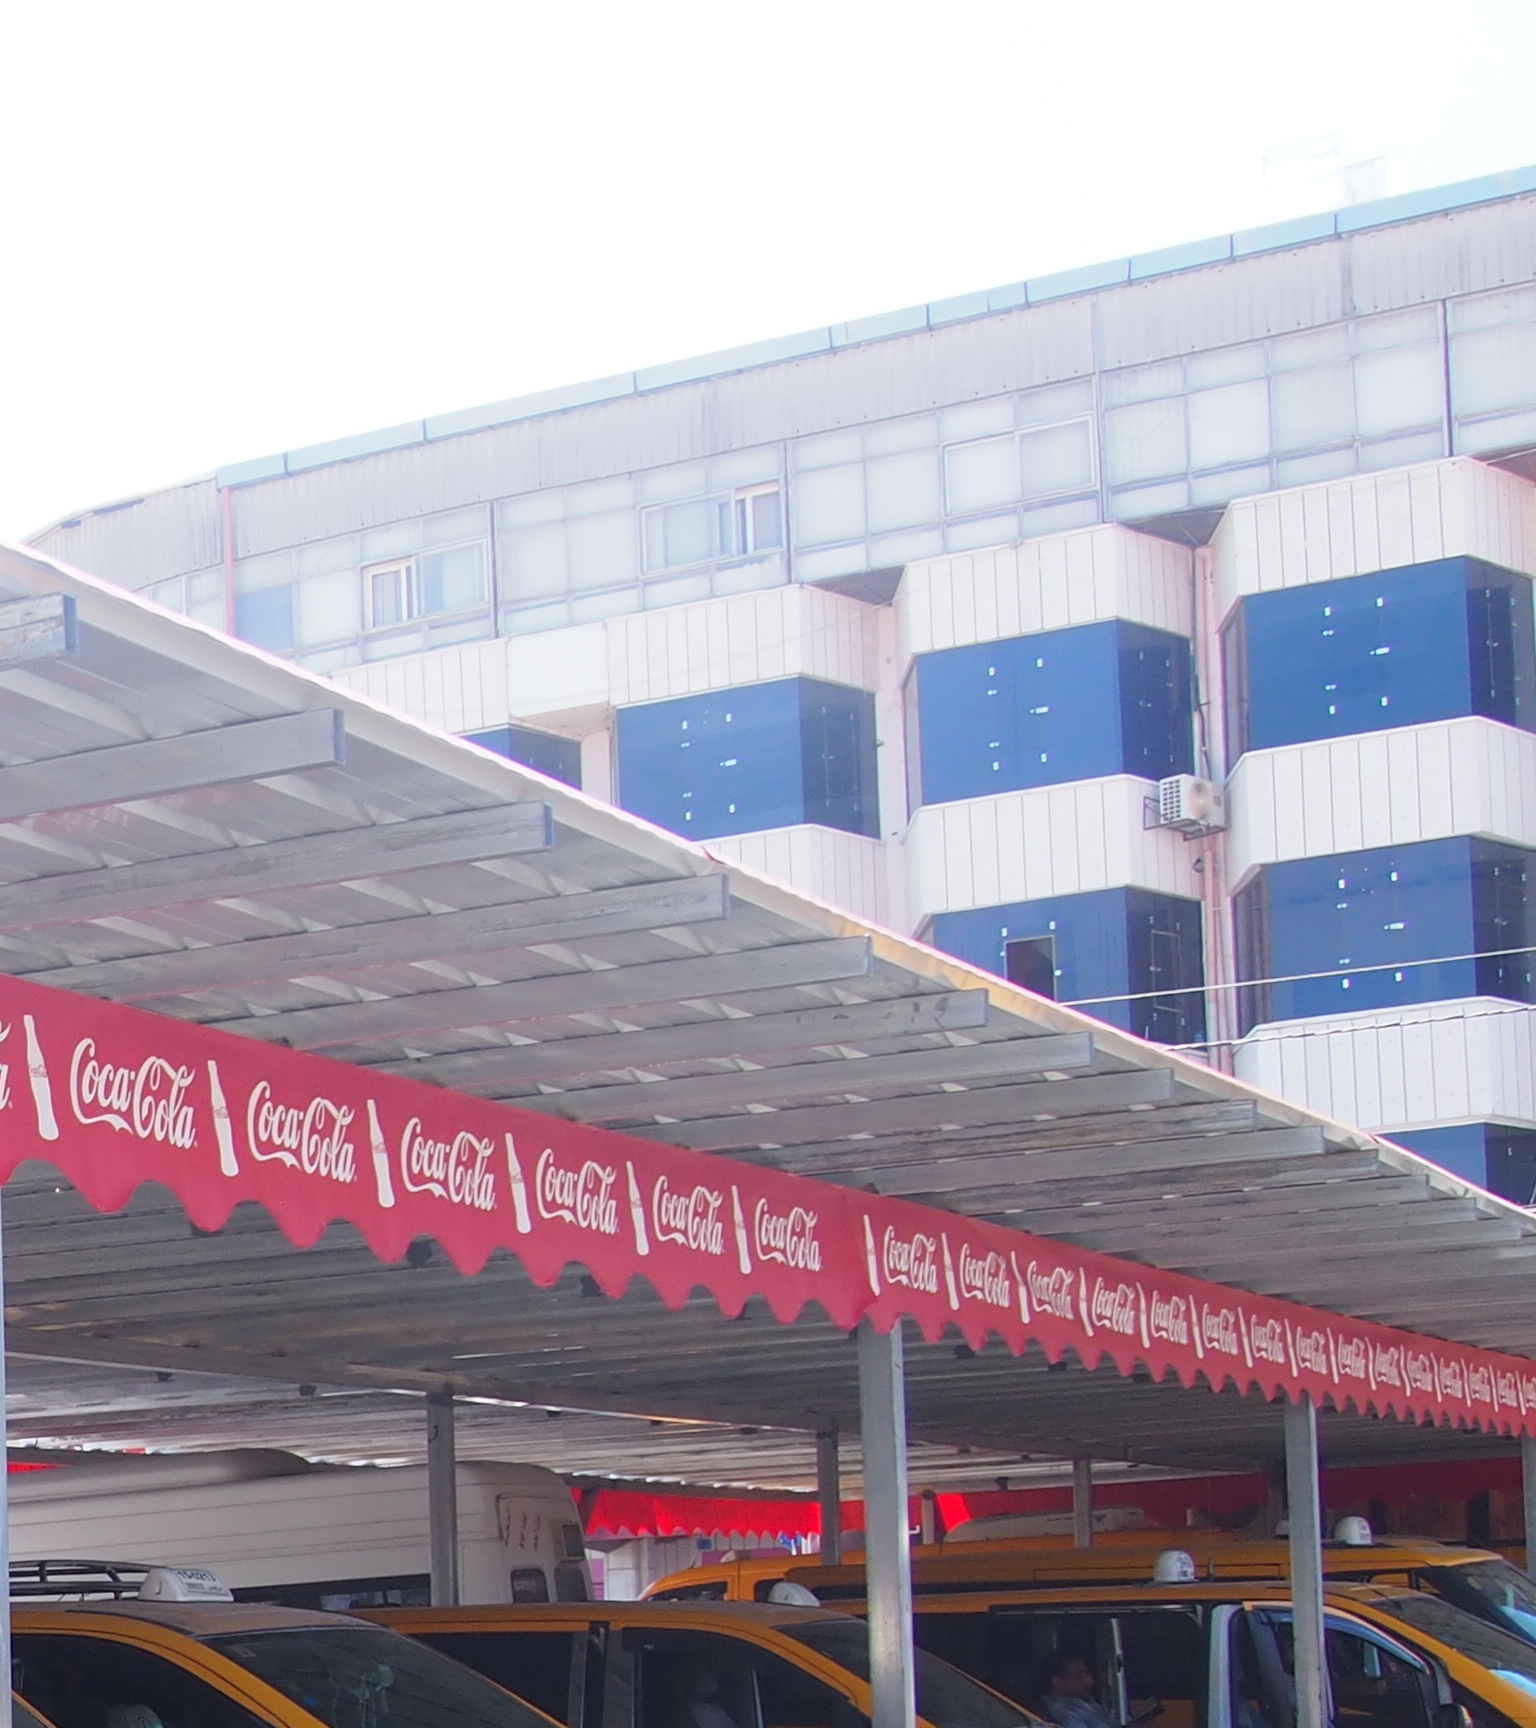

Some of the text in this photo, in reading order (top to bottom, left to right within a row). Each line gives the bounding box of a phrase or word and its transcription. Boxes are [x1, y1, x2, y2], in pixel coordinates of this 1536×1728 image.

[70, 1037, 195, 1149] Coca-Cola
[248, 1081, 355, 1184] Coca-Cola
[401, 1117, 495, 1211] Coca-Cola
[536, 1148, 618, 1234] Coca-Cola
[653, 1175, 724, 1256] Coca-Cola
[755, 1198, 821, 1272] Coca-Cola
[883, 1225, 938, 1294] Coca-Cola
